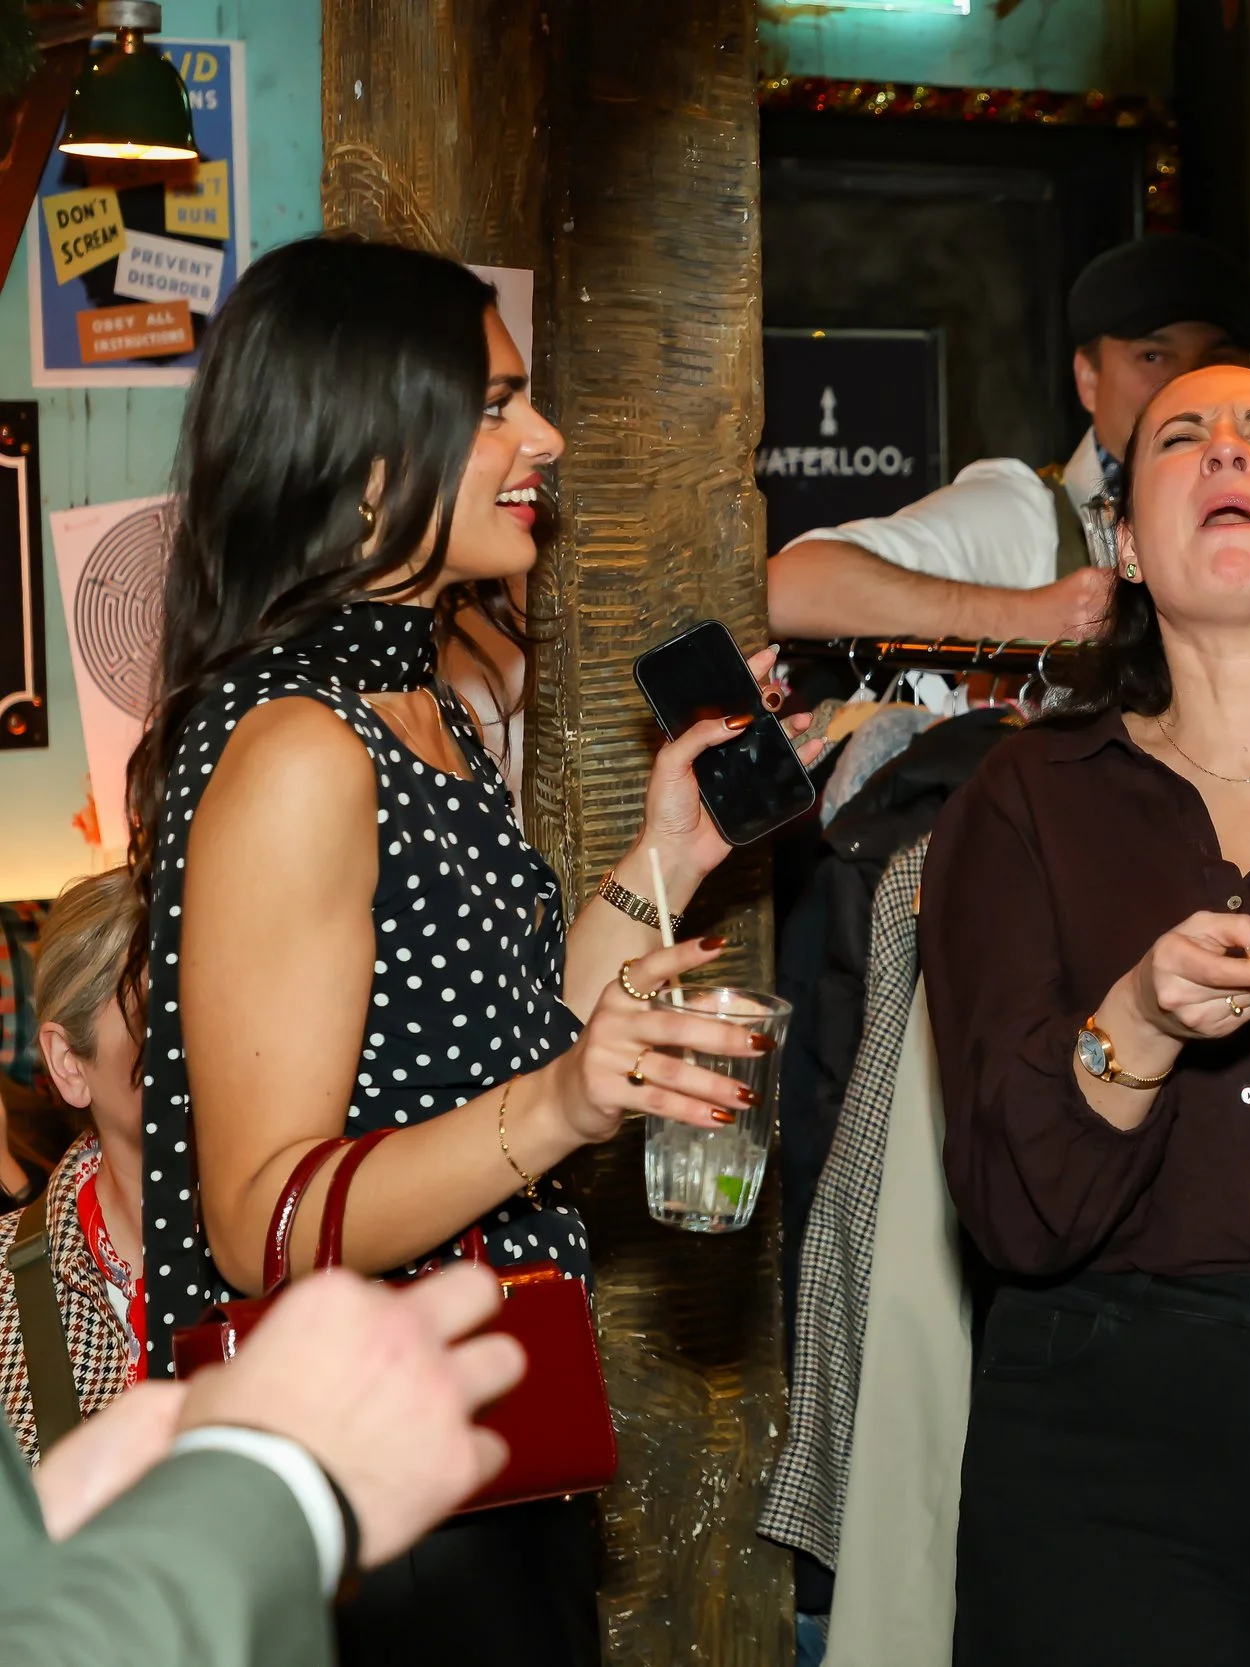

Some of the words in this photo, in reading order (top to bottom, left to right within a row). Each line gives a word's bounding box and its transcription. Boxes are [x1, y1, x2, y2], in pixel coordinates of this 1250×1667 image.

[56, 198, 109, 229] DON'T
[177, 207, 217, 224] RUN
[60, 223, 119, 265] SCREAM
[130, 246, 214, 278] PREVENT
[127, 269, 211, 300] DISORDER
[91, 315, 136, 334] OBEY
[146, 310, 175, 327] ALL
[93, 328, 186, 353] INSTRUCTIONS
